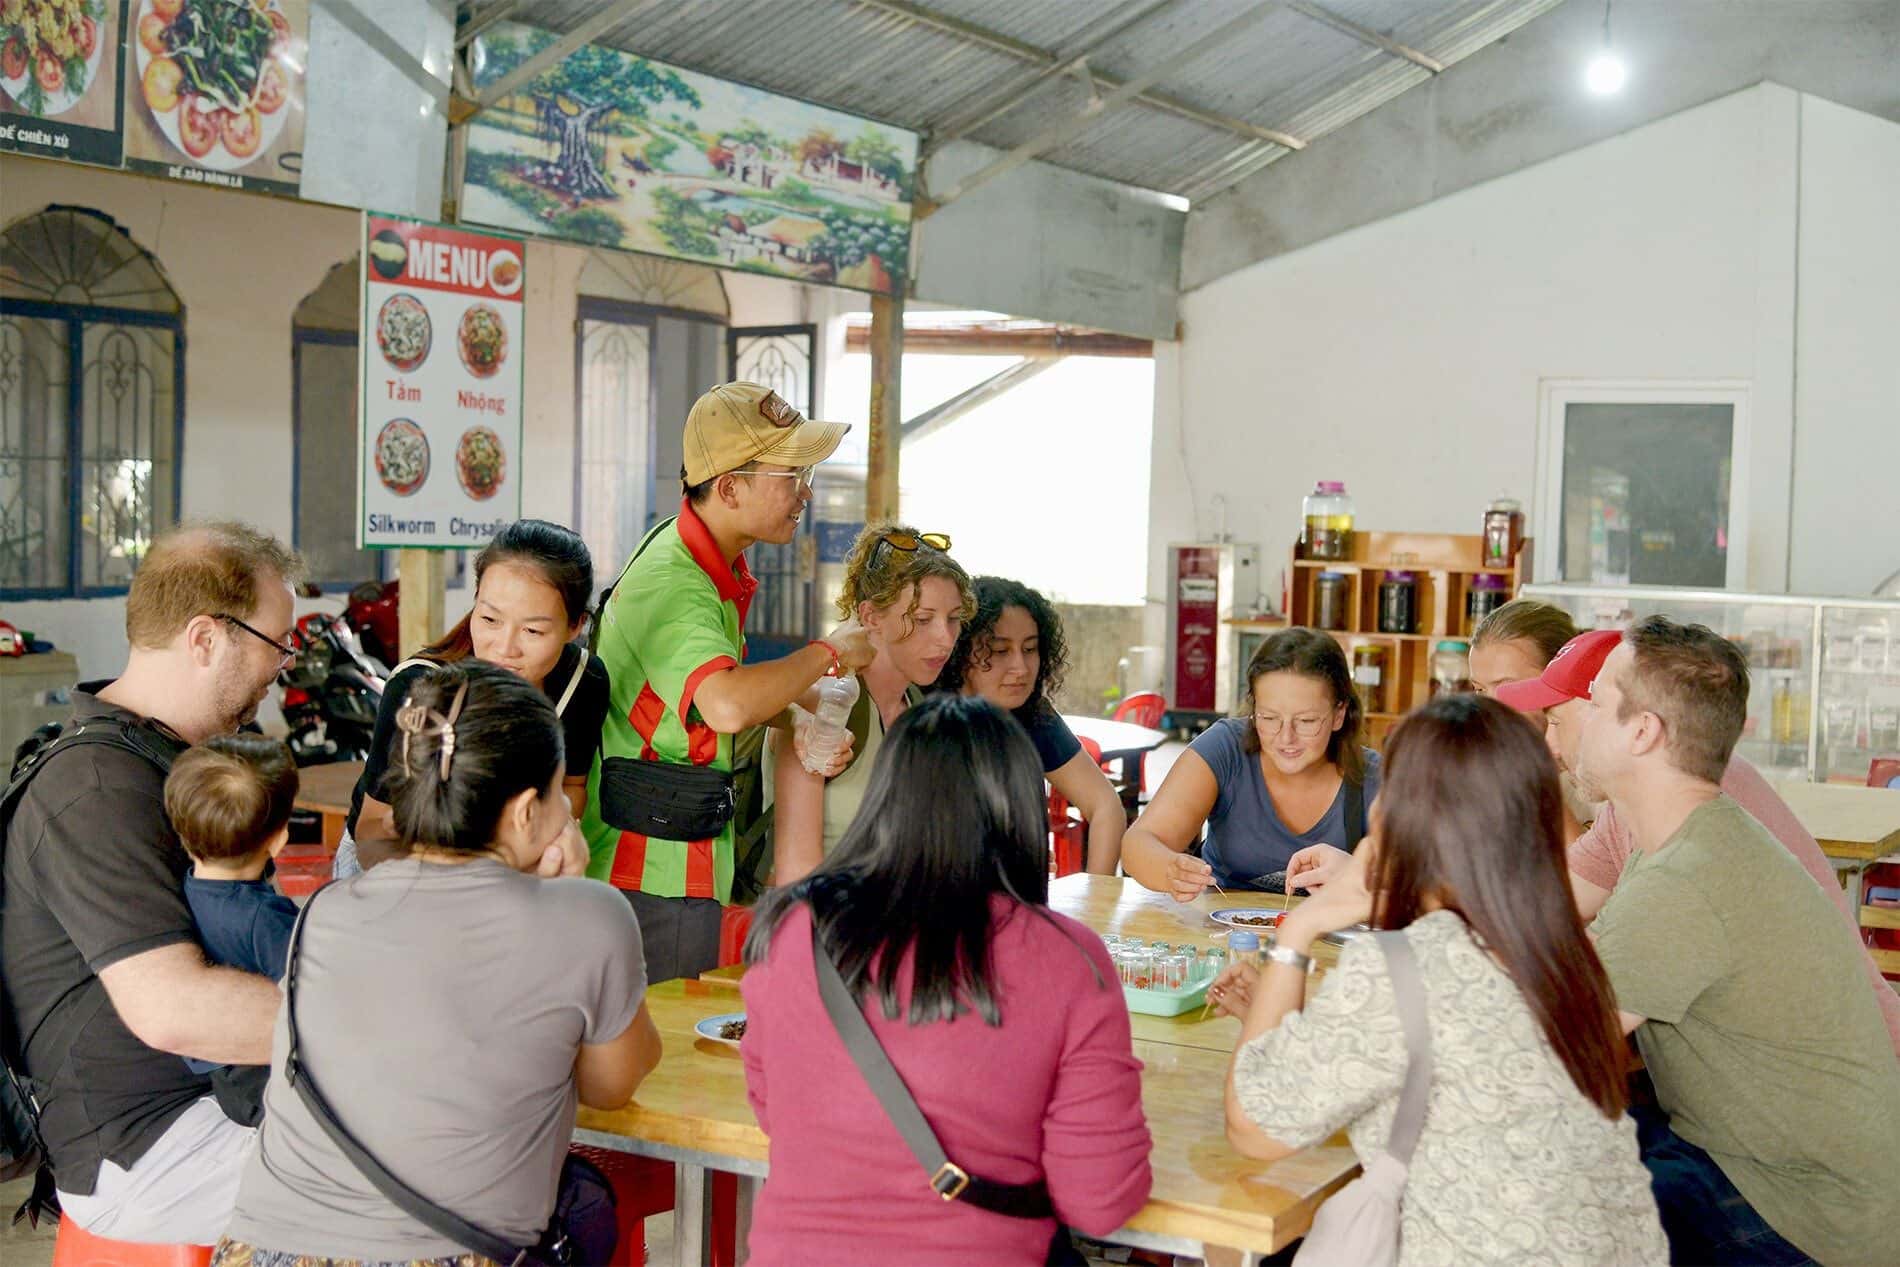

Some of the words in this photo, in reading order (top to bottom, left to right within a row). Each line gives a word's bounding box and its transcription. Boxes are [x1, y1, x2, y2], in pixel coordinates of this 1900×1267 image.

[408, 239, 487, 289] MENU
[458, 389, 505, 416] Nhộng
[369, 513, 436, 535] Silkworm
